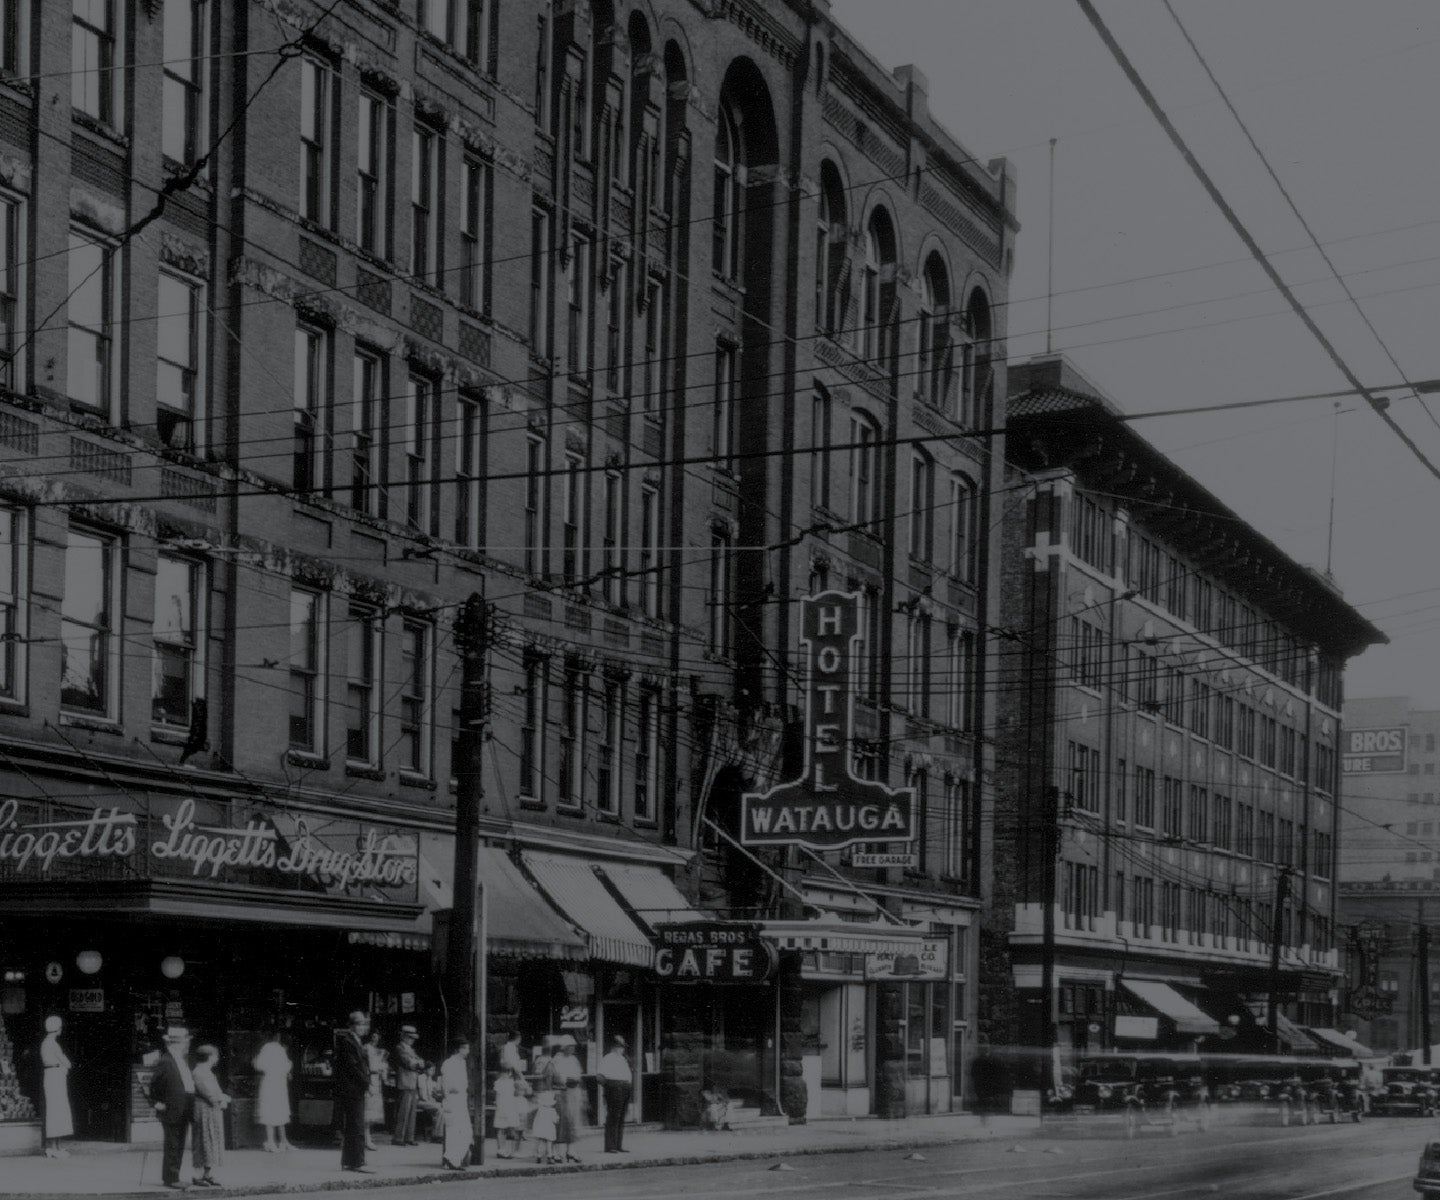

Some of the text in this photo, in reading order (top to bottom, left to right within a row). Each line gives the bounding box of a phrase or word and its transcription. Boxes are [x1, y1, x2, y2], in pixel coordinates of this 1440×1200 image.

[814, 605, 843, 792] HOTEL
[751, 803, 906, 834] WATAUGA
[150, 799, 279, 877] Liggett's
[277, 818, 354, 890] Drug
[352, 828, 418, 884] Store
[856, 855, 912, 865] FREE GARAGE
[663, 930, 704, 944] REGAS
[655, 948, 753, 977] CAFE
